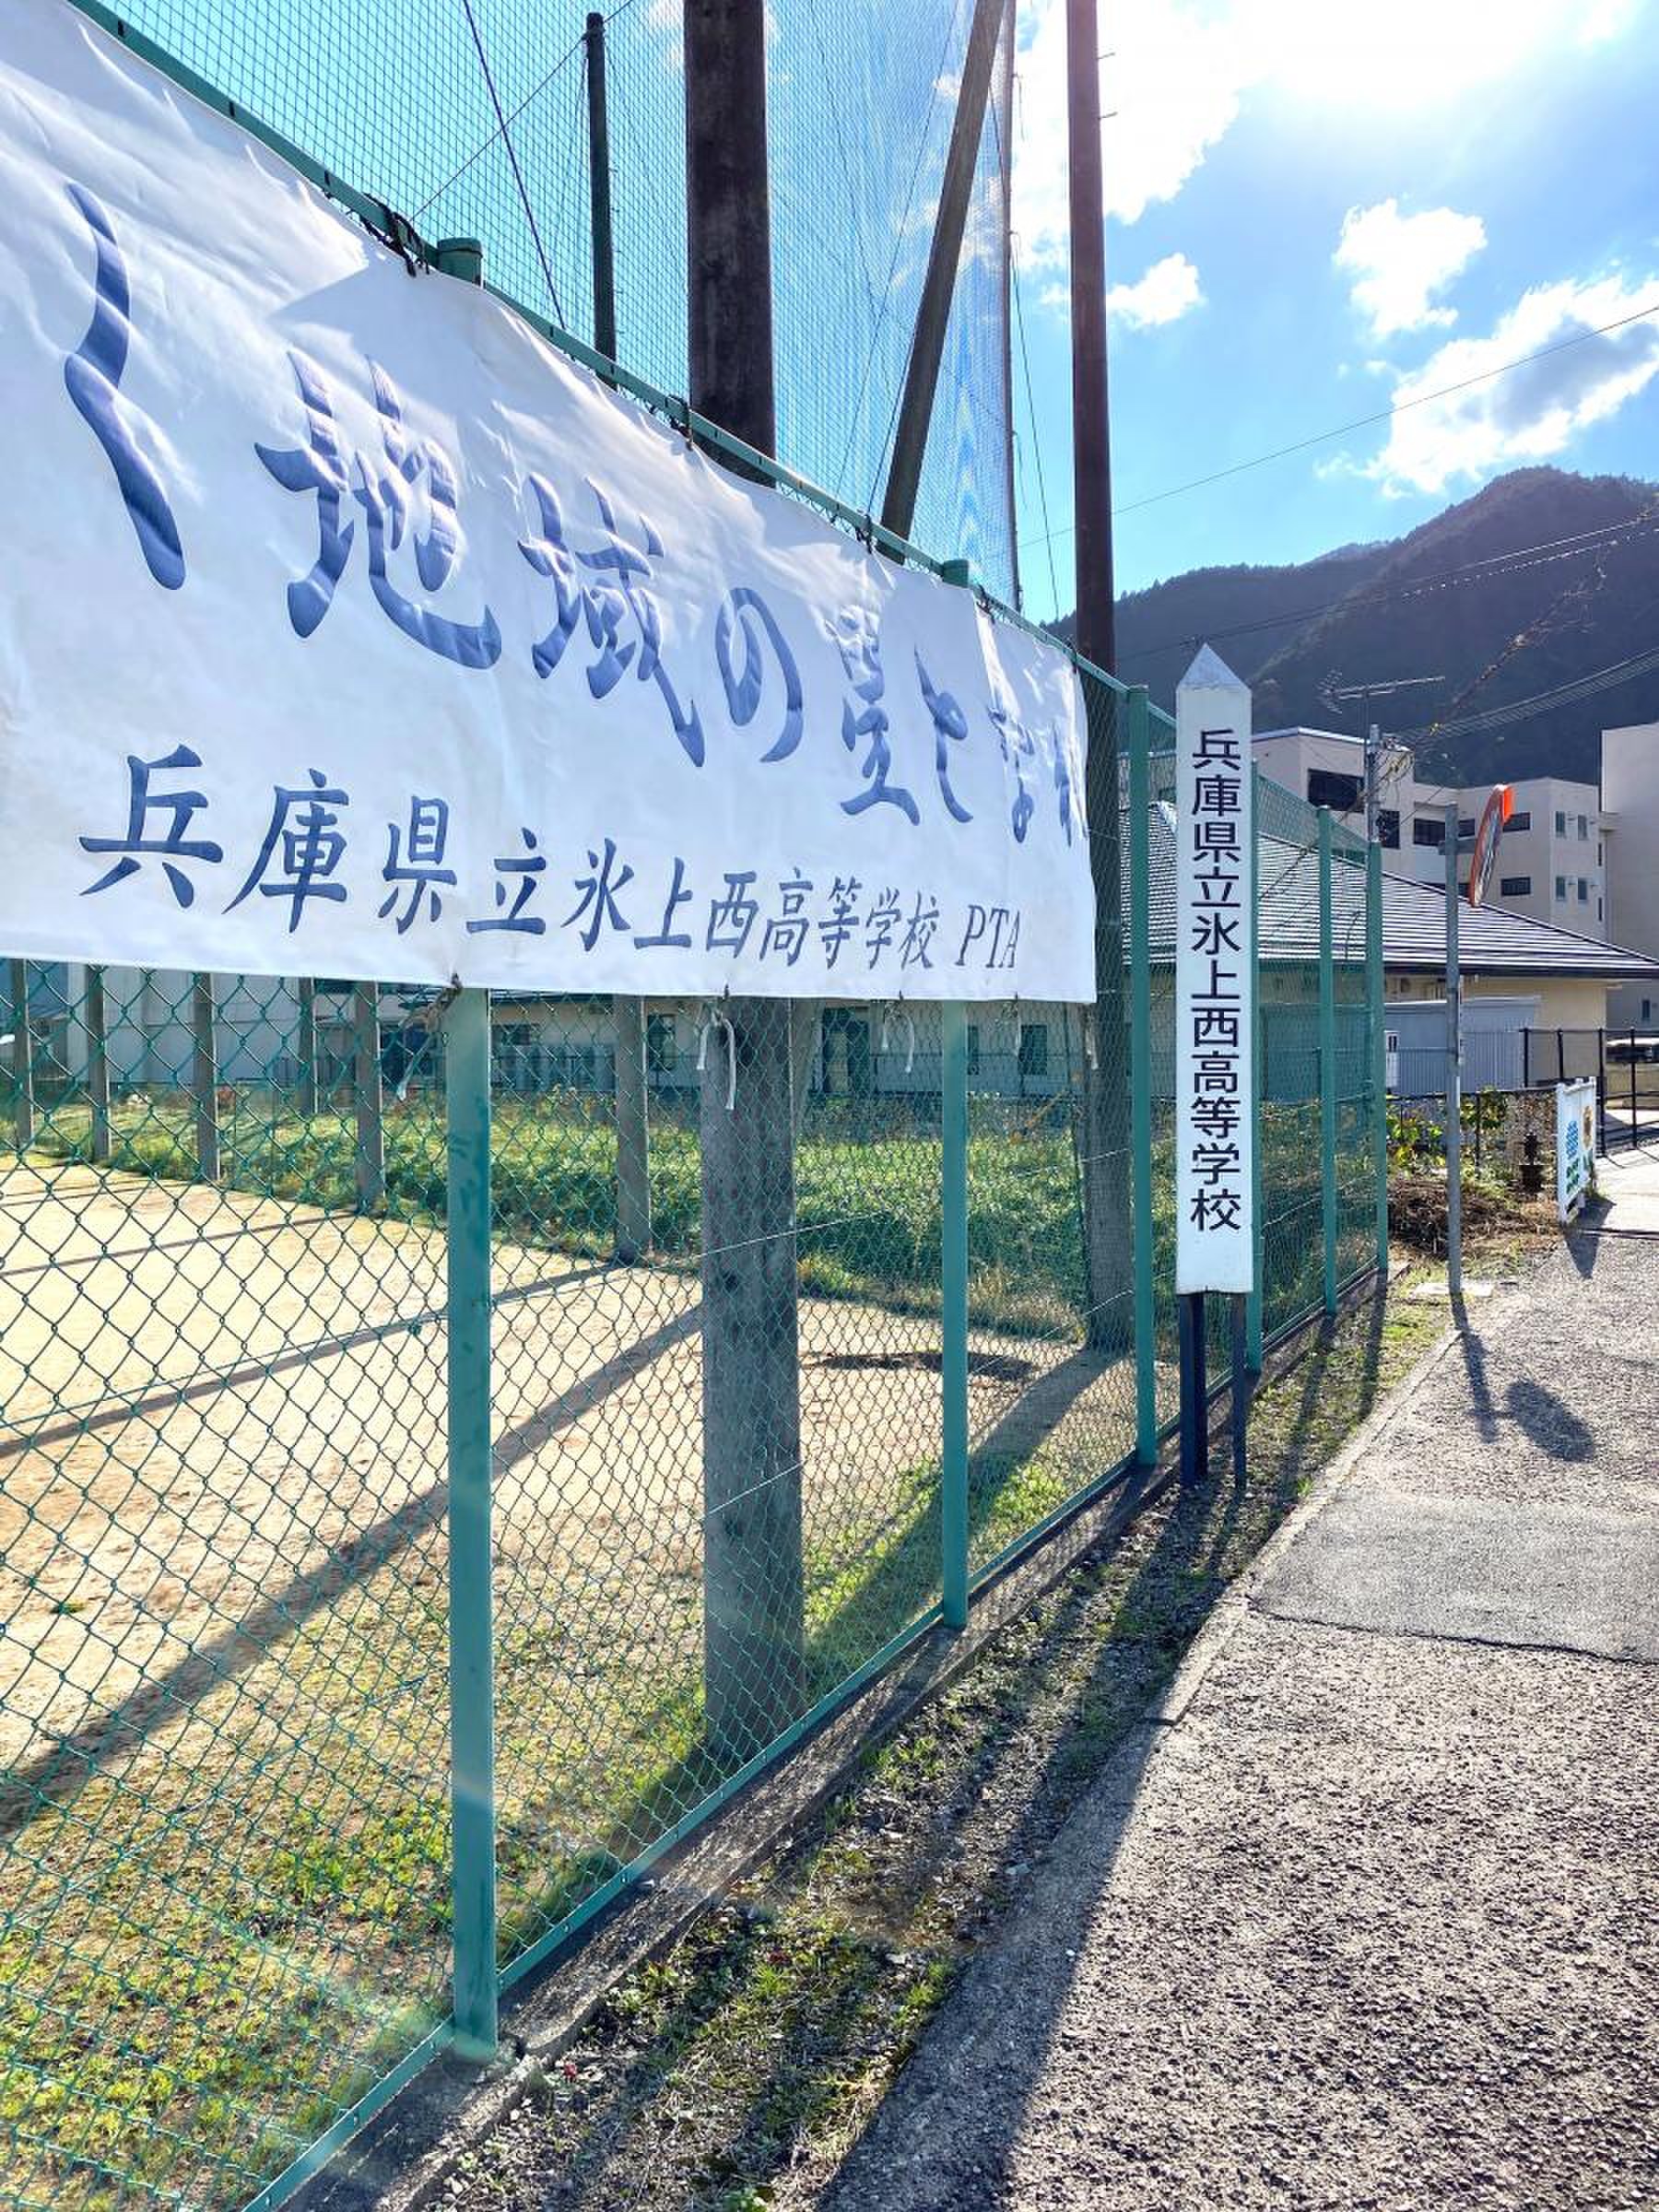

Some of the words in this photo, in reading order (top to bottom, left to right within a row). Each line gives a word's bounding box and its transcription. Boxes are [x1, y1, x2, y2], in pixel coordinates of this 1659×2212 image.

[79, 744, 940, 971] 兵庫県立氷上西高等学校
[954, 903, 1020, 969] PTA
[1190, 729, 1241, 1232] 兵庫県立氷上西高等学校
